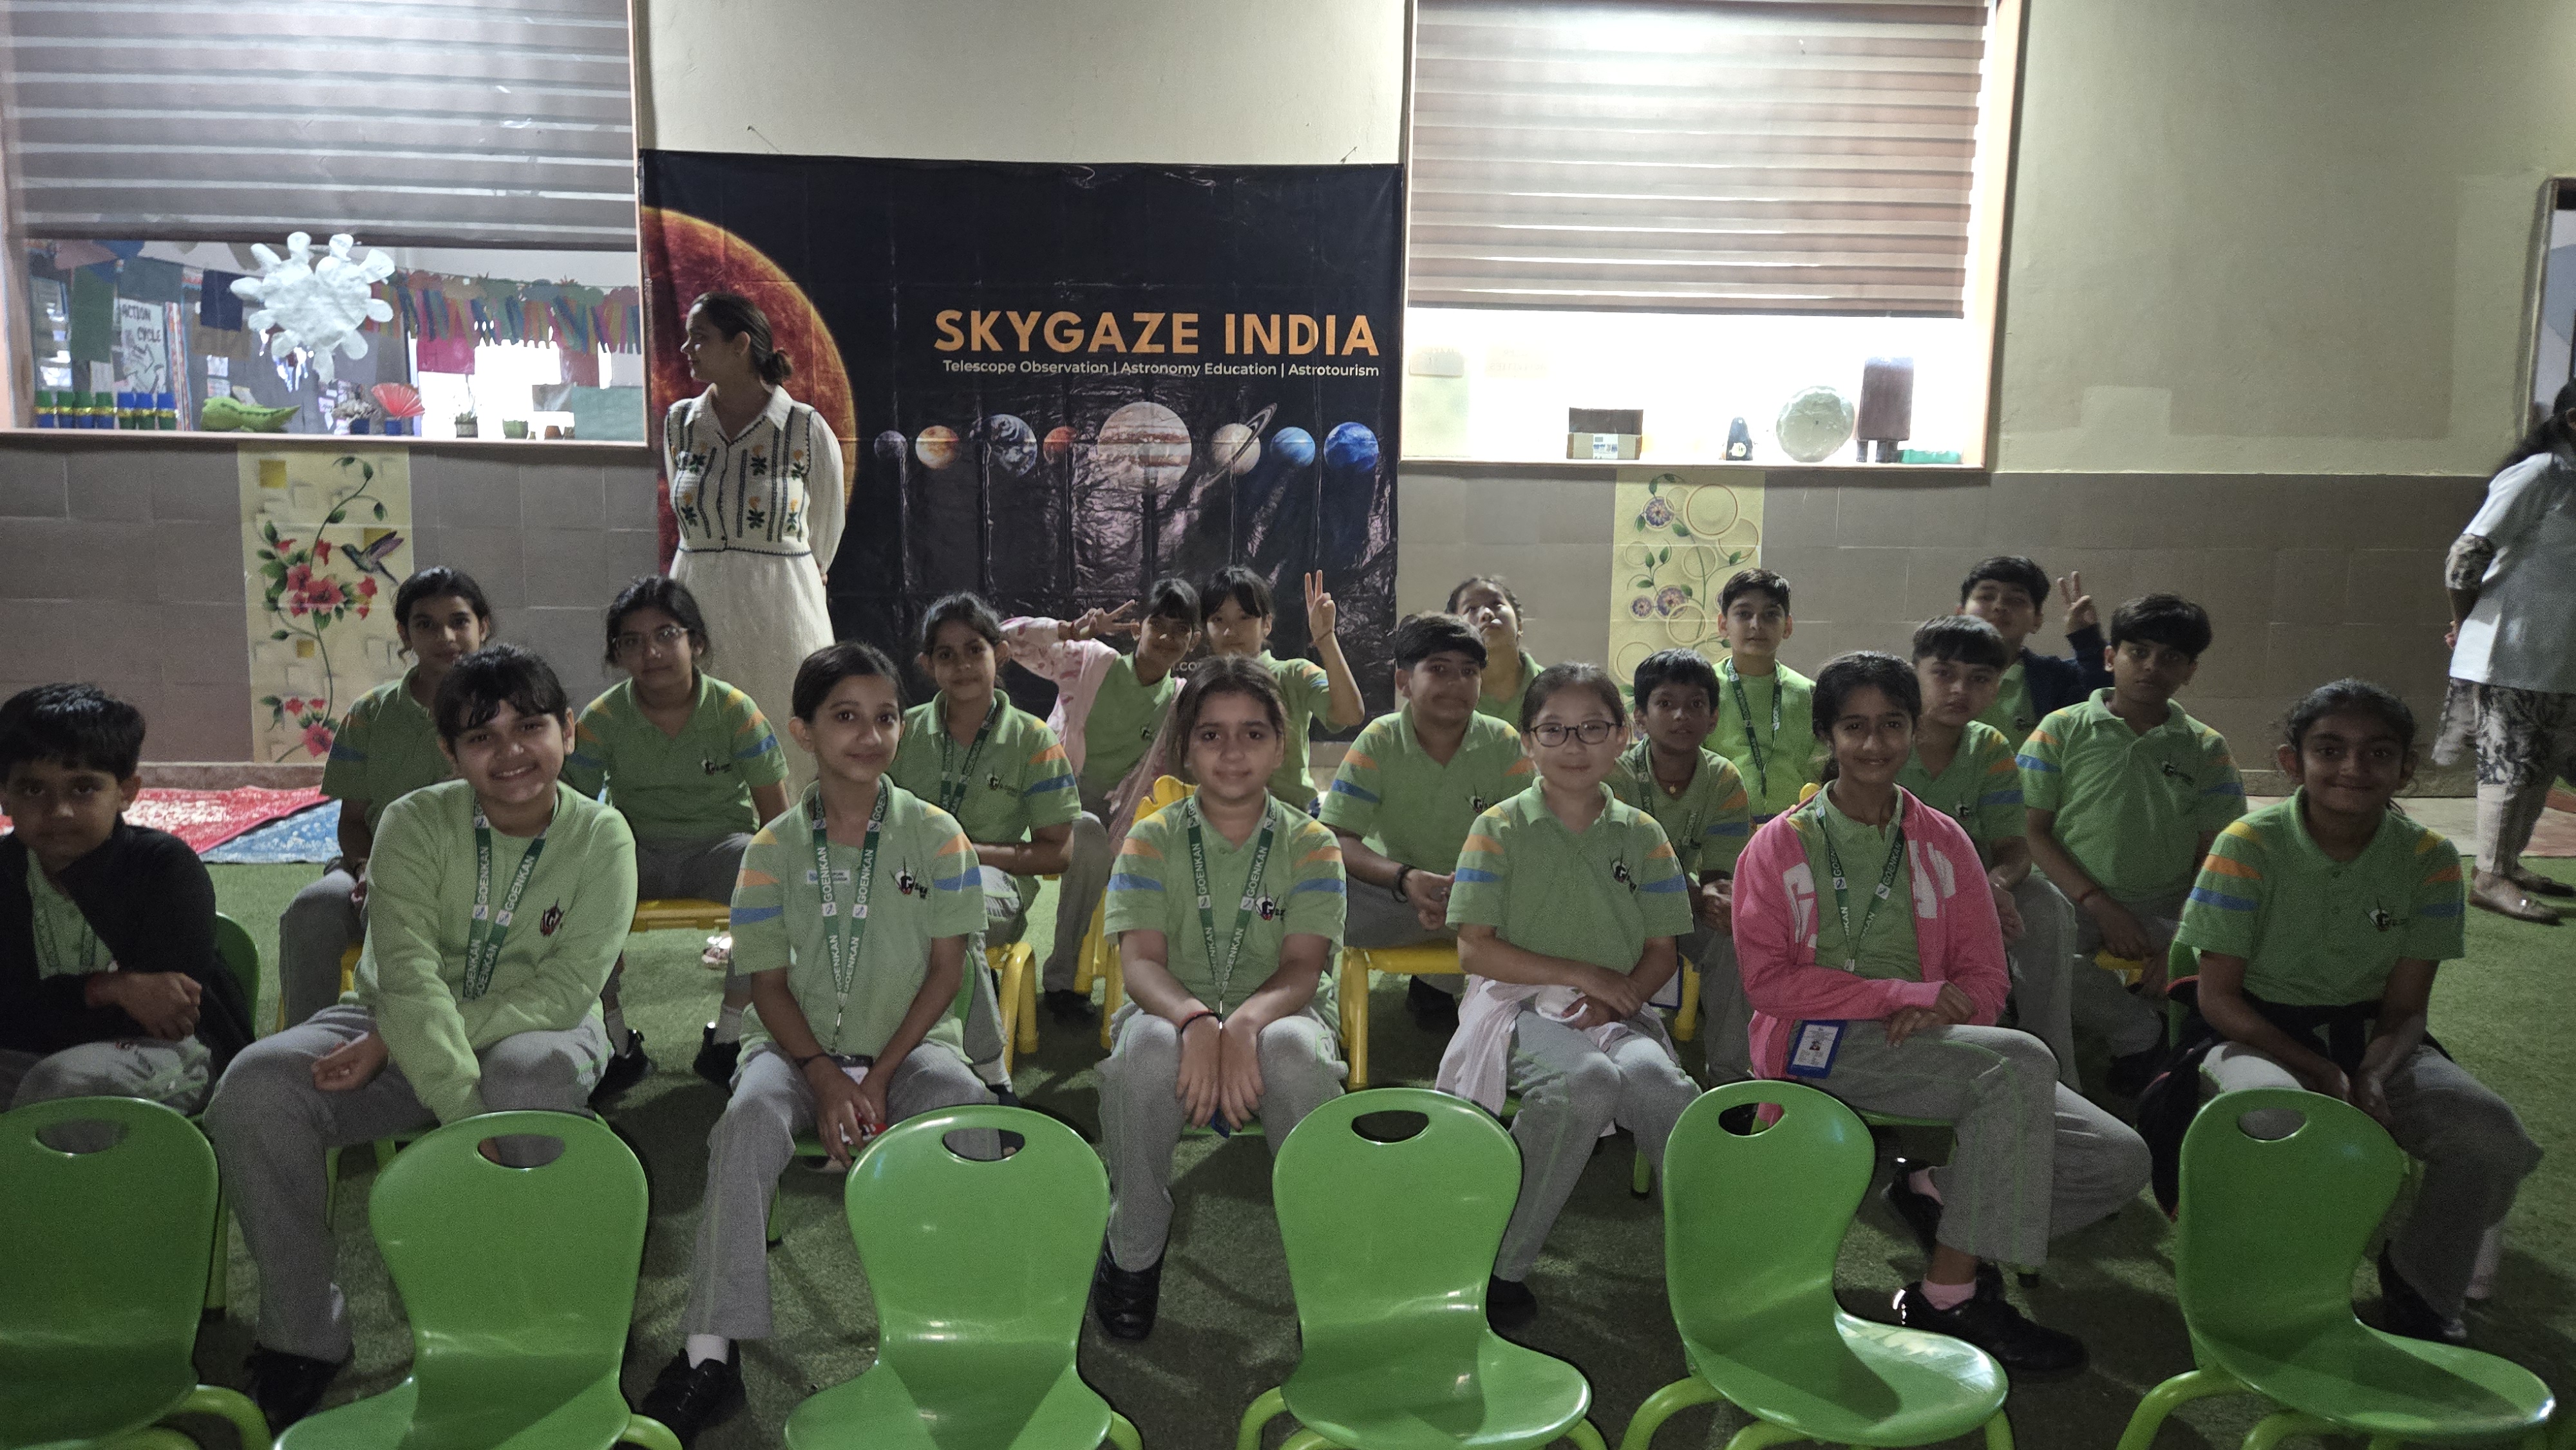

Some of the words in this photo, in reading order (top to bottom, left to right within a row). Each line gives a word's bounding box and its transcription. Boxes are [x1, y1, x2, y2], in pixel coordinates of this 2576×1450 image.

[137, 326, 161, 343] CYCLE
[934, 309, 1198, 354] SKYGAZE
[1225, 313, 1379, 355] INDIA
[943, 359, 1016, 374] Telescope
[1019, 360, 1109, 373] Observation
[1121, 362, 1200, 377] Astronomy
[1204, 362, 1276, 375] Education
[1289, 363, 1379, 376] Astrotourism
[477, 846, 490, 905] GOENKAN
[504, 855, 535, 911] GOENKAN
[817, 847, 833, 901] GOENKAN
[857, 849, 874, 904] GOENKAN
[1191, 843, 1208, 894] GOENKAN
[1246, 845, 1269, 897] GOENKAN
[1882, 842, 1902, 886] GOENKAN
[829, 934, 842, 990] GOENKAN
[844, 936, 860, 992] GOENKAN
[1224, 928, 1244, 981] GOENKAN
